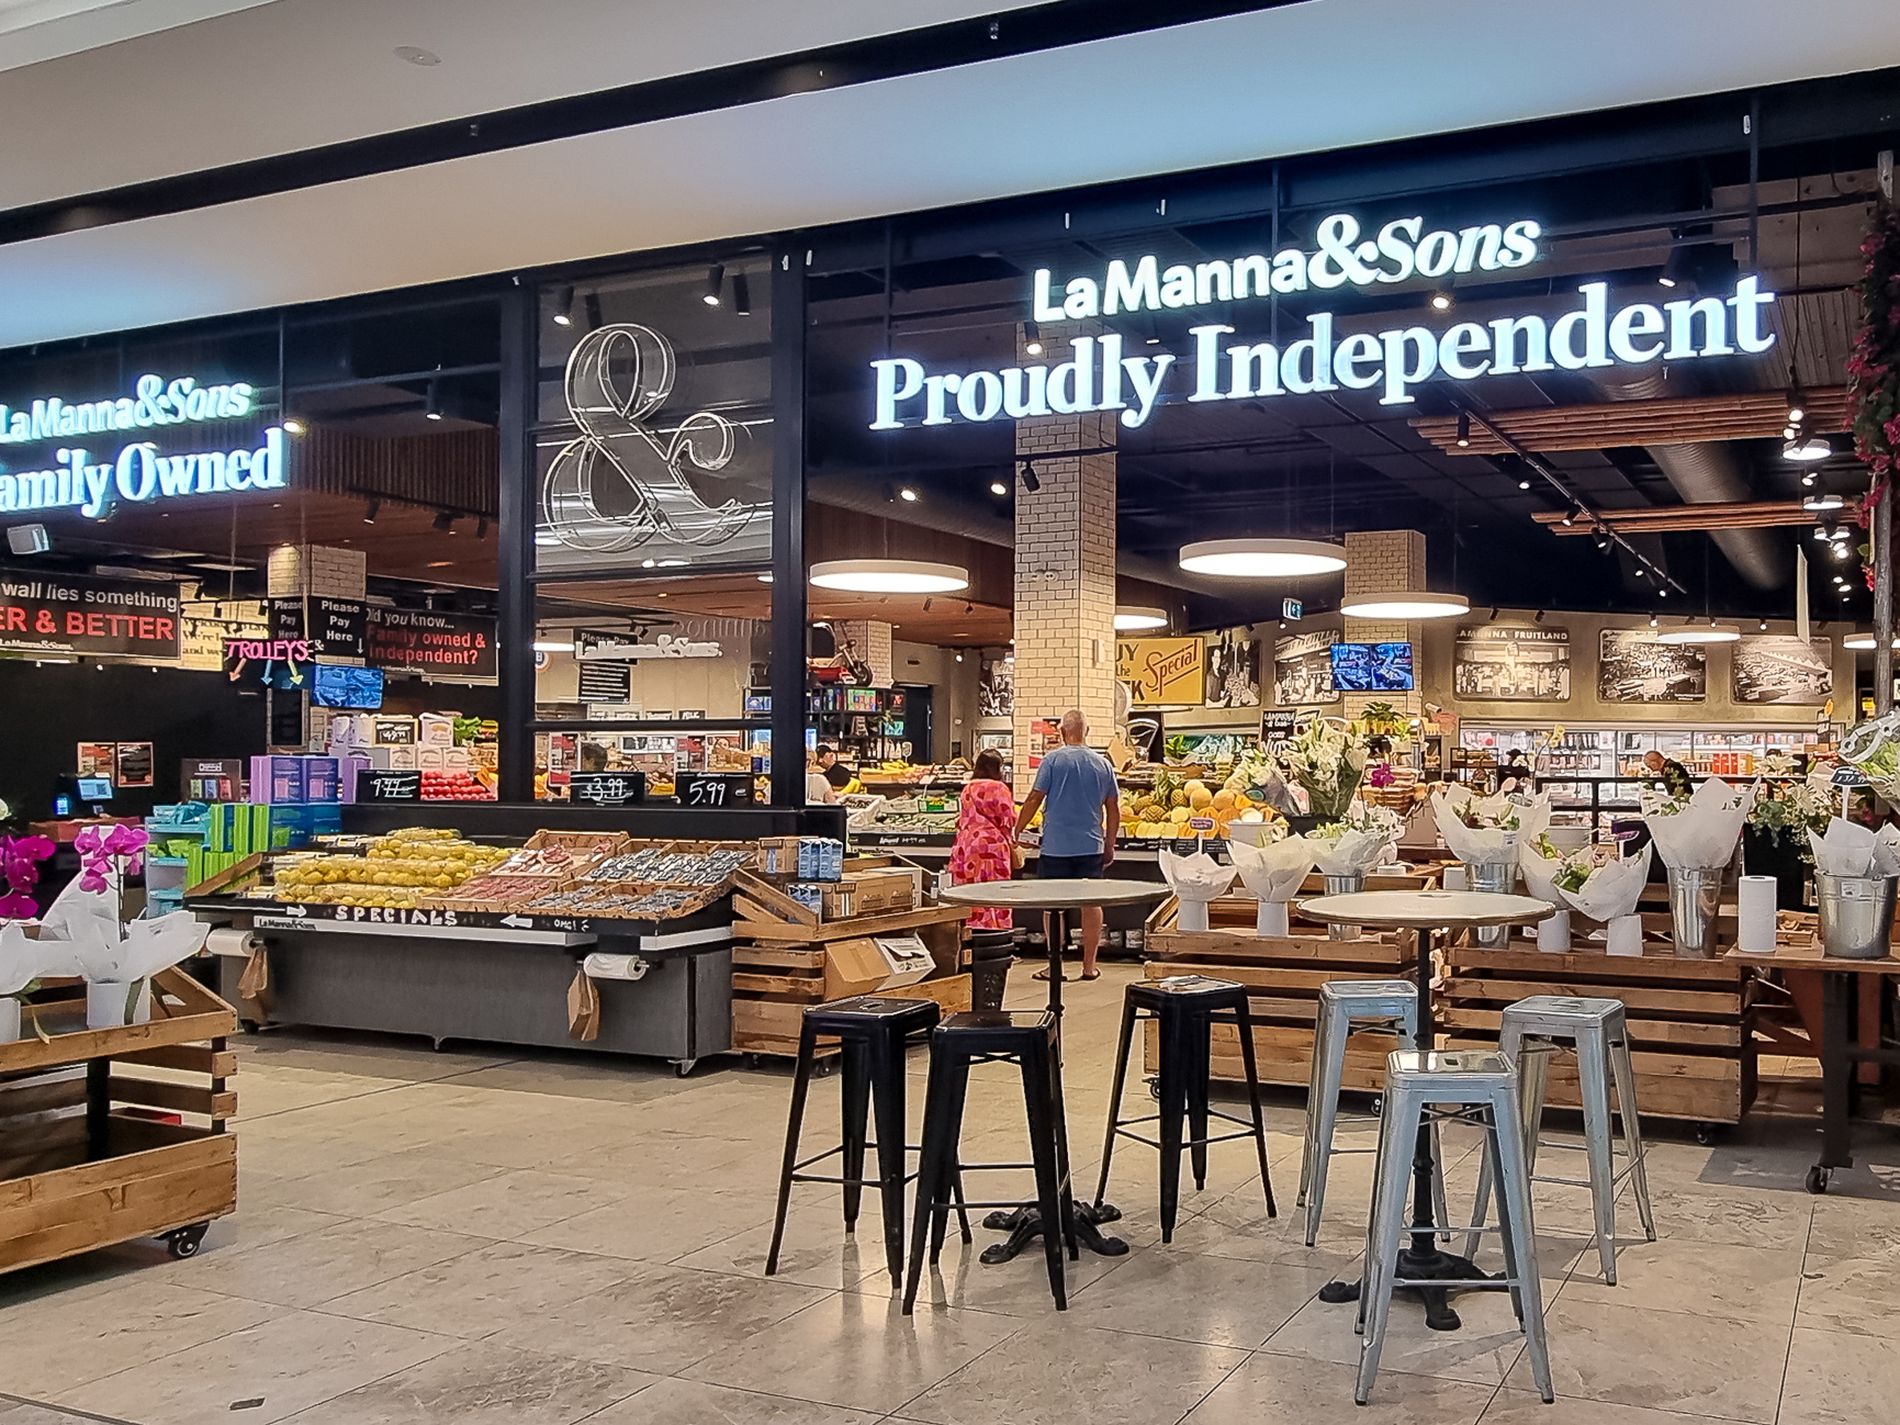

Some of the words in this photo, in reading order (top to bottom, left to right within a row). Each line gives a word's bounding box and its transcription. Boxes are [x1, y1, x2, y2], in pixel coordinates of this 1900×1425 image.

[1032, 214, 1542, 322] LaManna&Sons
[870, 333, 1177, 428] Proudly
[1189, 274, 1776, 405] Independent
[116, 427, 287, 501] Owned
[1, 582, 42, 599] wall
[46, 583, 79, 601] lies
[85, 590, 178, 613] something
[321, 600, 360, 613] Please
[36, 609, 56, 634] &
[66, 611, 174, 640] BETTER
[280, 614, 296, 626] Pay
[329, 615, 351, 628] Pay
[385, 613, 408, 626] you
[326, 630, 354, 641] Here
[423, 633, 470, 648] owned
[475, 633, 486, 648] &
[1515, 630, 1568, 640] FRUITLAND
[224, 640, 309, 661] TROLLEYS
[369, 648, 478, 664] Independent?
[1146, 639, 1198, 697] Special
[689, 780, 726, 805] 5.99
[335, 906, 458, 927] SPECIALS
